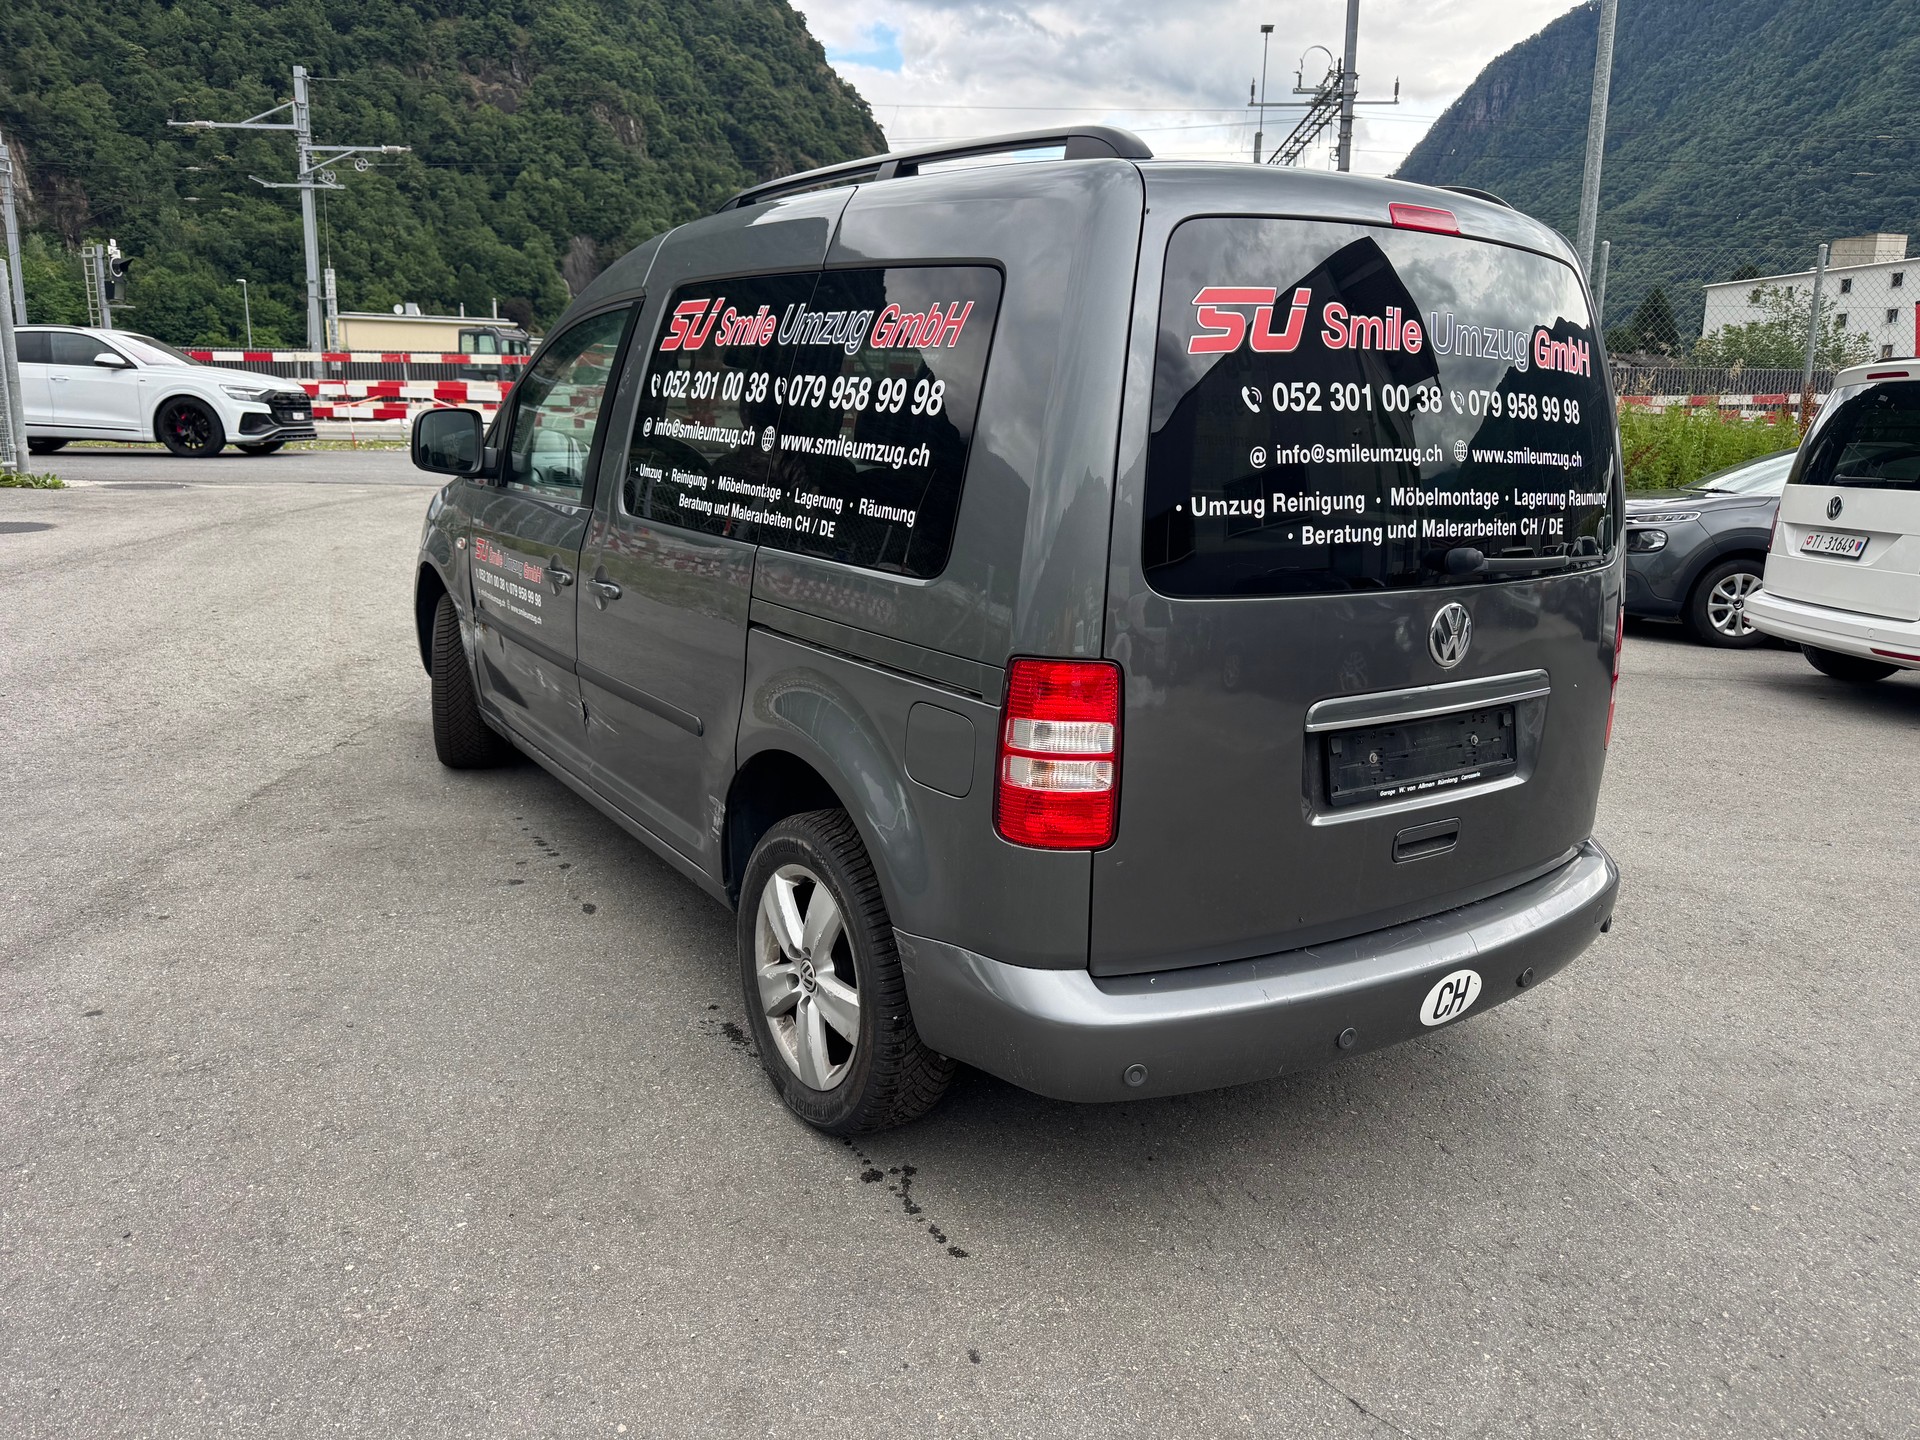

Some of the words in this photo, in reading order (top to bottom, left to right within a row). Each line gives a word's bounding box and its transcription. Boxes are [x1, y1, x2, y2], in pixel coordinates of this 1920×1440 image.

[660, 297, 725, 351] SU
[715, 305, 776, 347] Smile
[777, 302, 874, 355] Umzug
[870, 300, 974, 348] GmbH
[1187, 286, 1312, 354] SU
[1321, 301, 1423, 354] Smile
[1430, 311, 1530, 373] Umzug
[1534, 328, 1591, 378] GmbH
[662, 370, 691, 398] 052
[690, 371, 720, 400] 301
[721, 371, 744, 401] 00
[745, 372, 770, 403] 38
[788, 374, 827, 408] 079
[829, 375, 872, 411] 958
[875, 377, 907, 414] 99
[911, 379, 946, 416] 98
[1272, 381, 1323, 412] 052
[1329, 382, 1372, 412] 301
[1381, 384, 1409, 413] 00
[1416, 385, 1443, 414] 38
[1468, 389, 1502, 418] 079
[1507, 392, 1538, 420] 958
[1541, 395, 1560, 422] 99
[1563, 398, 1580, 424] 98
[654, 417, 756, 449] info@smileumzug.ch
[780, 433, 931, 470] www.smileumzug.ch
[1276, 443, 1443, 467] info@smileumzug.ch
[1472, 447, 1583, 470] www.smileumzug.ch
[640, 463, 663, 483] Umzug
[671, 468, 708, 491] Reinigung
[718, 475, 782, 502] Möbelmontage
[794, 487, 843, 515] Lagerung
[858, 498, 916, 528] Räumung
[1191, 496, 1265, 519] Umzug
[1273, 491, 1365, 514] Reinigung
[1390, 487, 1499, 510] Möbelmontage
[1514, 488, 1566, 510] Lagerung
[679, 493, 713, 517] Beratung
[714, 502, 731, 517] und
[731, 503, 793, 530] Malerarbeiten
[794, 514, 811, 533] CH
[819, 519, 836, 538] DE
[1302, 524, 1383, 546] Beratung
[1387, 519, 1417, 539] und
[1422, 518, 1517, 538] Malerarbeiten
[1520, 517, 1538, 536] CH
[1540, 517, 1547, 536] /
[1549, 517, 1564, 535] DE
[528, 590, 535, 604] 99
[535, 592, 542, 607] 98
[1432, 975, 1471, 1019] CH
